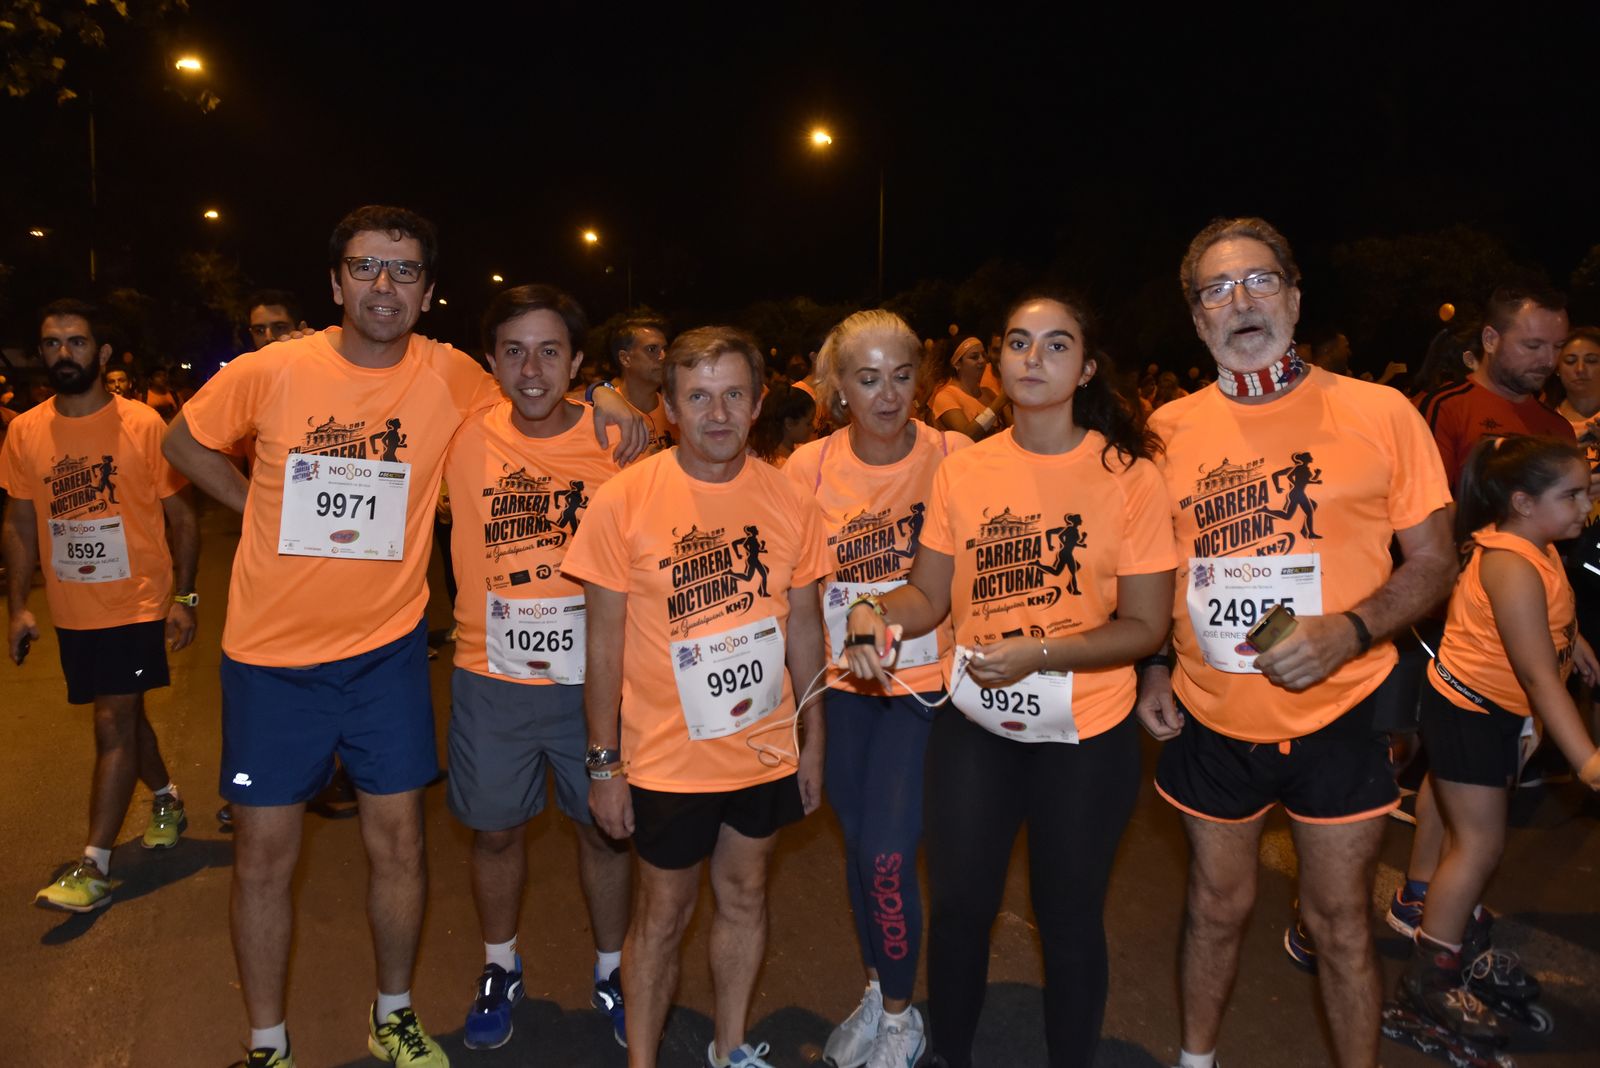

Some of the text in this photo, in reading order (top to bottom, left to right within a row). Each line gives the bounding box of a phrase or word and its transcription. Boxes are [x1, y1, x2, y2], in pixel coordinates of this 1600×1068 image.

[52, 469, 92, 496] CARRERA
[50, 489, 96, 517] NOCTURNA
[316, 491, 377, 520] 9971
[491, 495, 550, 517] CARRERA
[1194, 479, 1269, 529] CARRERA
[484, 515, 552, 544] NOCTURNA
[1194, 514, 1274, 558] NOCTURNA
[67, 542, 106, 559] 8592
[836, 525, 896, 565] CARRERA
[976, 535, 1042, 572] CARRERA
[672, 547, 733, 588] CARRERA
[836, 553, 900, 582] NOCTURNA
[667, 576, 738, 619] NOCTURNA
[972, 566, 1045, 600] NOCTURNA
[505, 629, 573, 652] 10265
[1220, 630, 1247, 641] ERNES
[707, 659, 763, 697] 9920
[980, 688, 1041, 717] 9925
[870, 851, 909, 961] adidas
